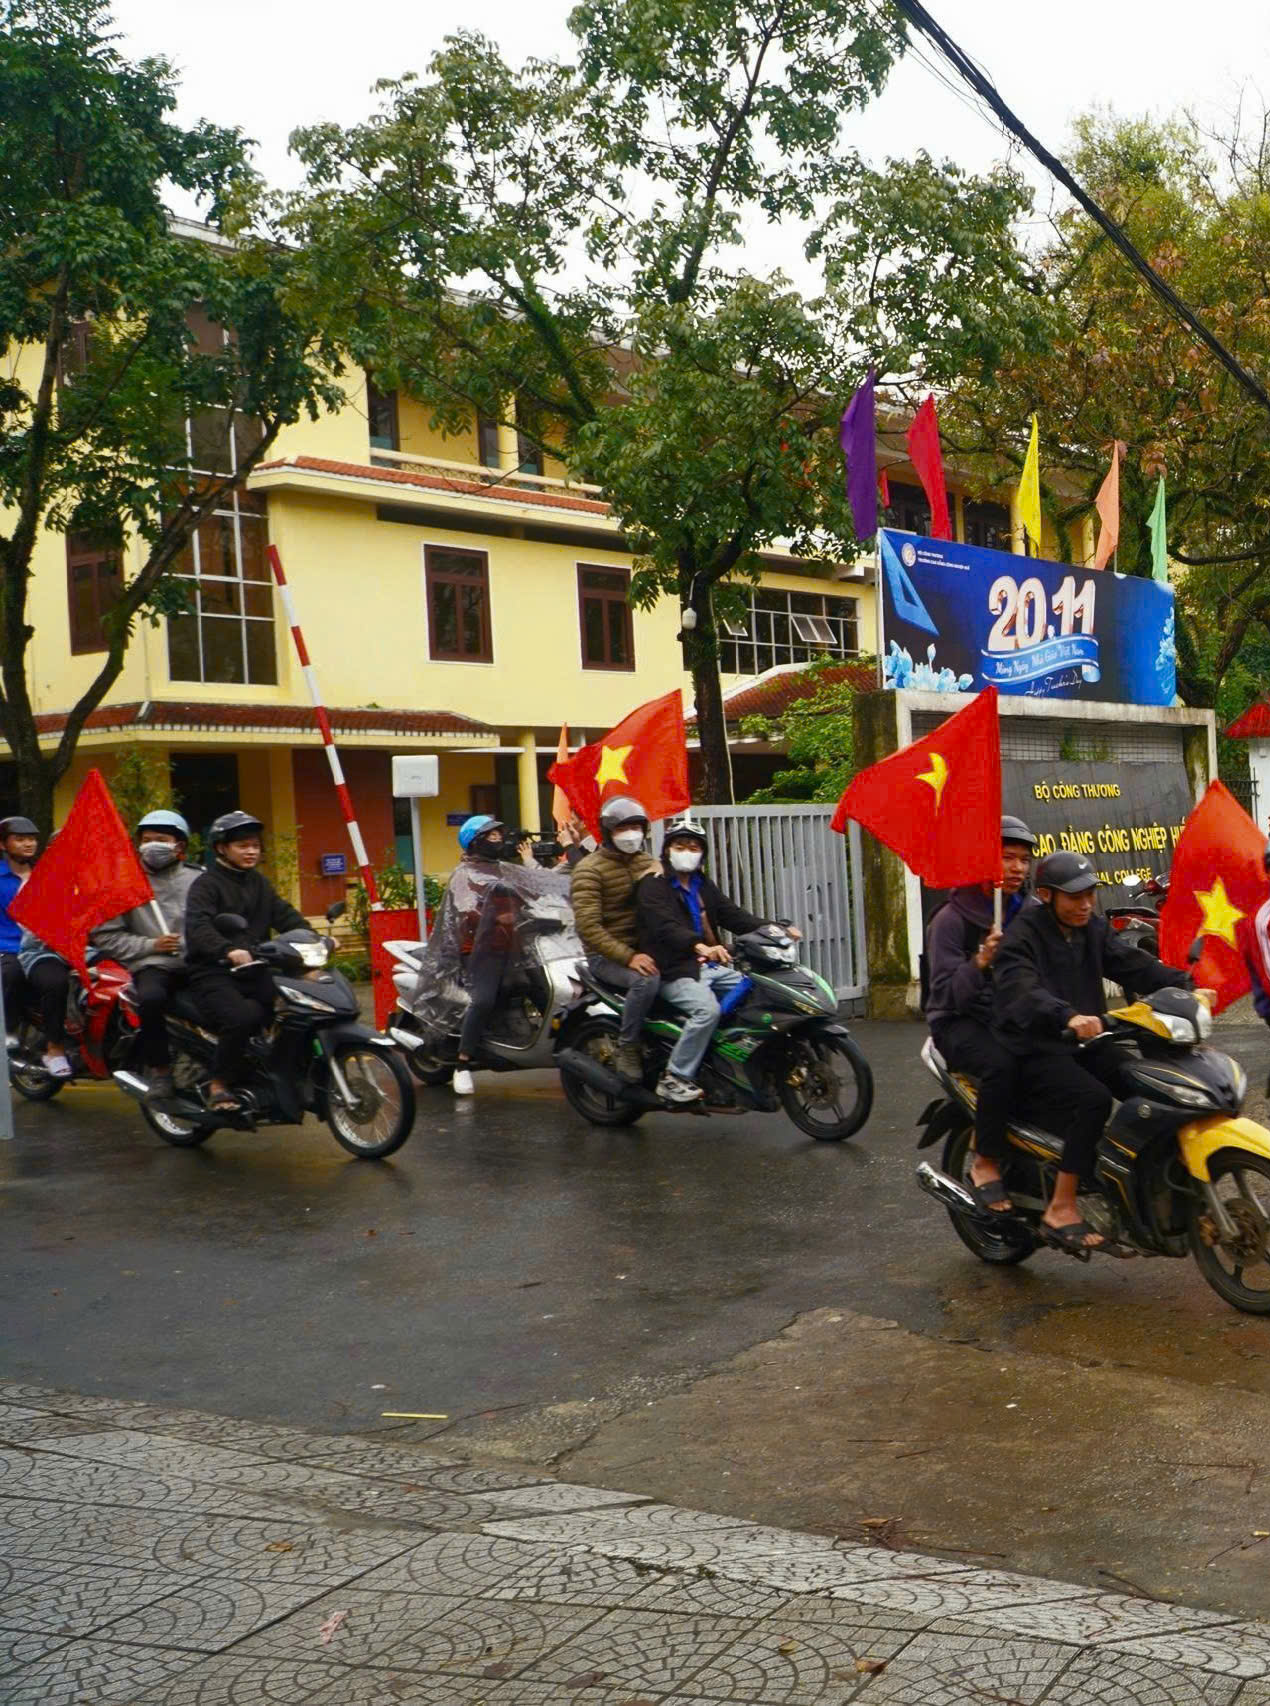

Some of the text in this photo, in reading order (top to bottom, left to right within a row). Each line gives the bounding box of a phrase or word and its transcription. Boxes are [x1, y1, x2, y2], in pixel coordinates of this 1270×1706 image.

[988, 576, 1096, 652] 20.11
[1034, 781, 1121, 803] BỘ CÔNG THƯƠNG
[1060, 825, 1095, 854] ĐẲNG
[1097, 824, 1130, 853] CÔNG
[1132, 822, 1167, 853] NGHIỆP
